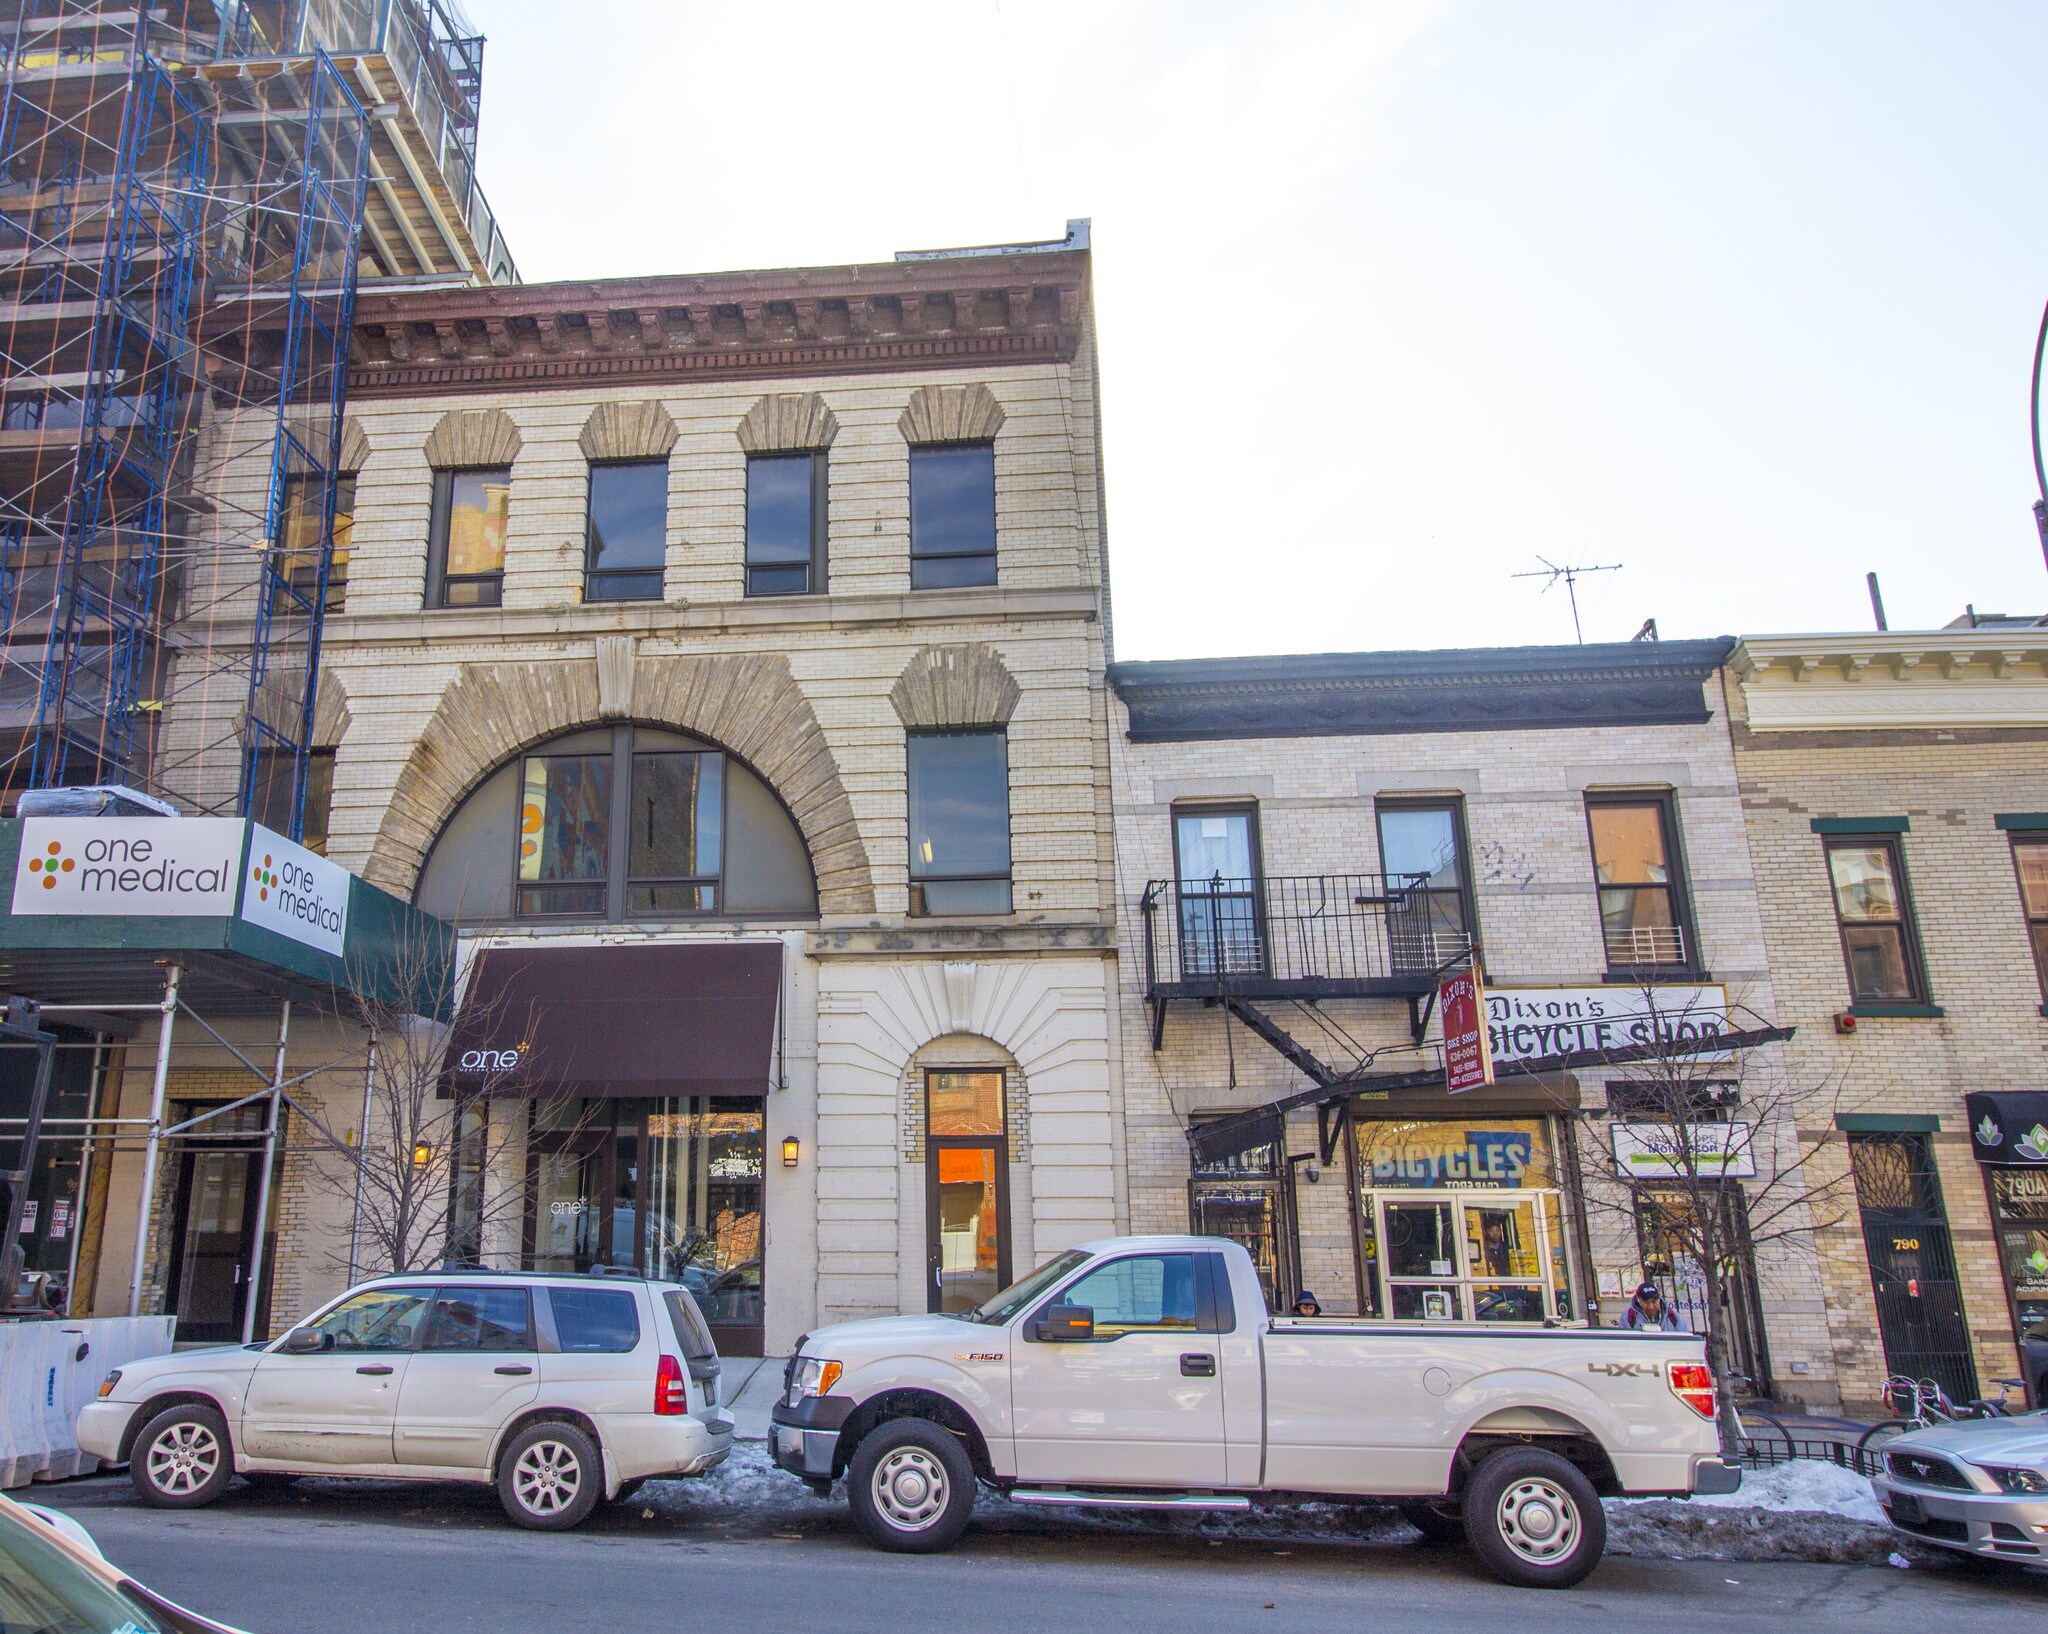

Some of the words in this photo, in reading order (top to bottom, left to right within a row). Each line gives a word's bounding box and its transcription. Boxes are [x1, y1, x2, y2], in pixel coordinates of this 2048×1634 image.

[84, 839, 152, 863] one
[80, 859, 229, 892] medical
[282, 861, 314, 894] one
[278, 887, 344, 936] medical
[1484, 996, 1604, 1021] Dixon's
[1461, 1031, 1478, 1045] SHOP
[1488, 1023, 1612, 1057] BICYCLE
[1630, 1022, 1720, 1046] SHOP
[461, 1050, 518, 1068] one
[1372, 1143, 1526, 1180] BICYCLES
[550, 1201, 582, 1215] one
[1892, 1238, 1920, 1250] 790
